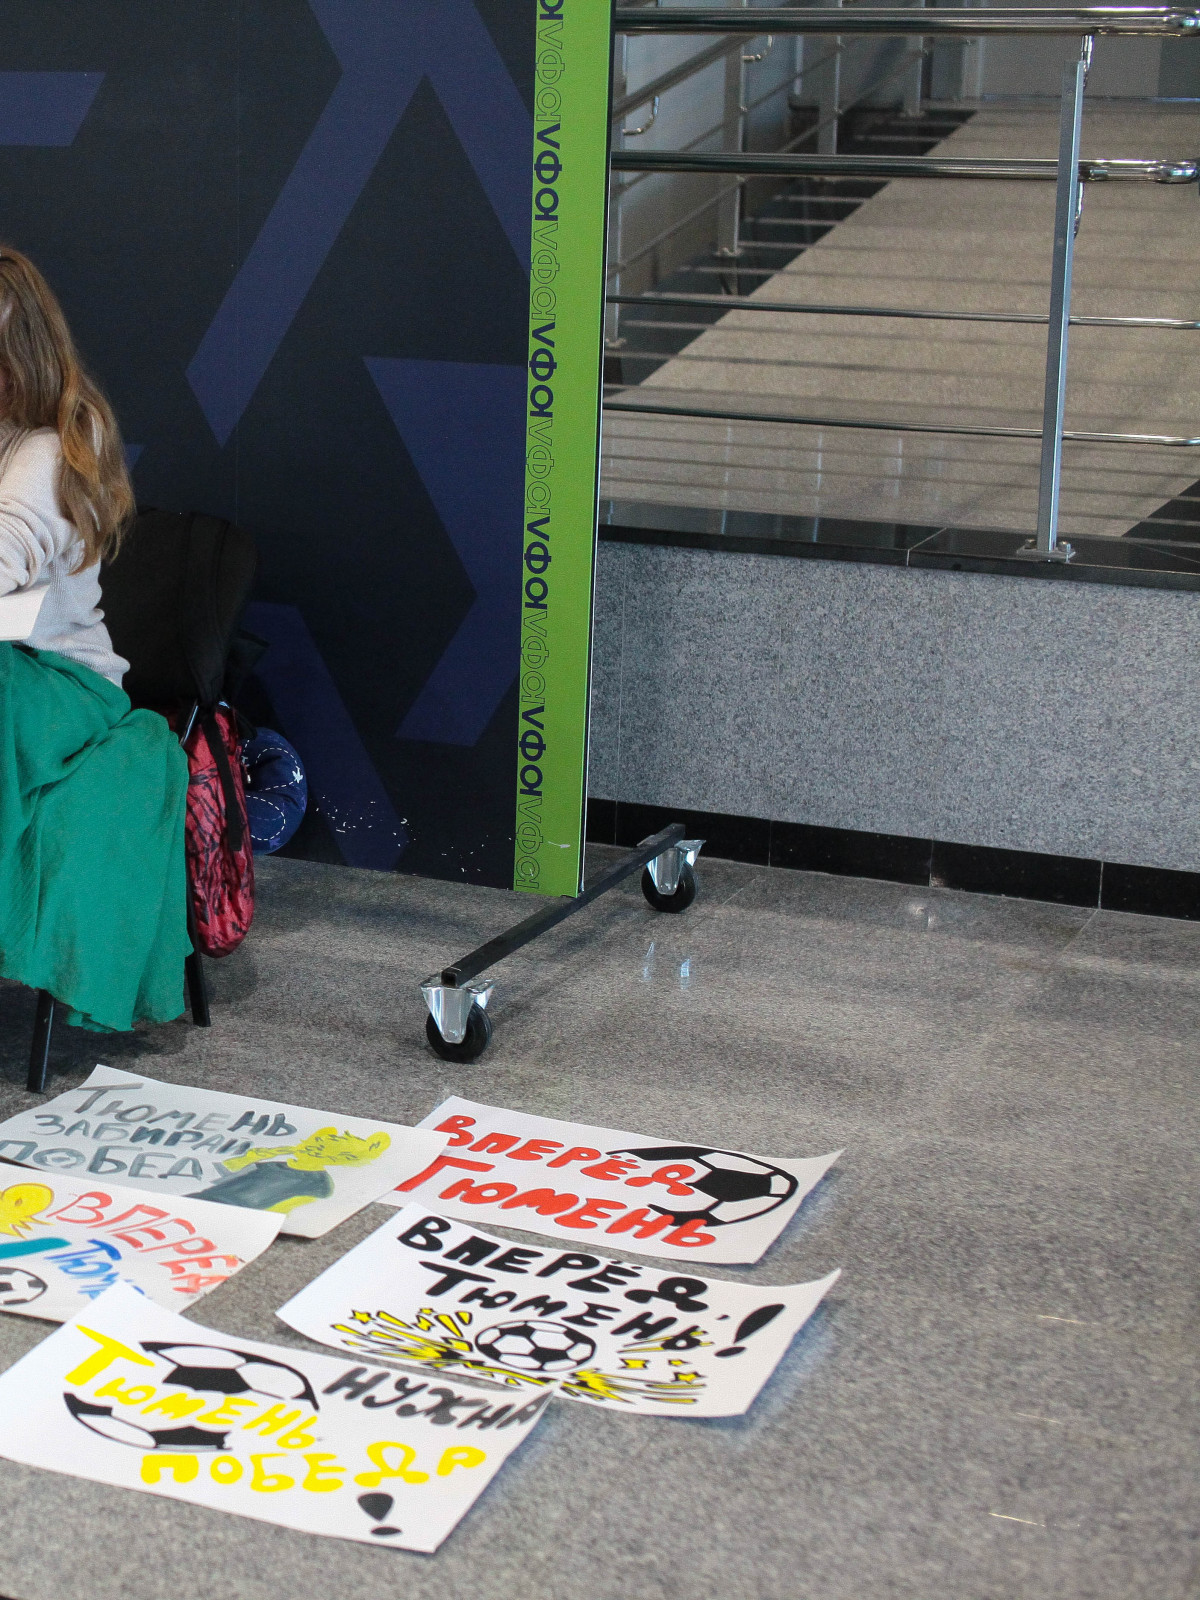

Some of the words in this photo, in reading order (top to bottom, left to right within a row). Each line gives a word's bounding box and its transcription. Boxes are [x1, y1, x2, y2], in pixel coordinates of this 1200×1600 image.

[29, 1113, 254, 1155] ЗАБИРАЙ
[74, 1082, 298, 1138] ТЮМЕНЬ
[432, 1114, 695, 1196] ВПЕРЁД
[393, 1154, 717, 1248] ТЮМЕНЬ
[63, 1324, 318, 1449] ТЮМЕНЬ
